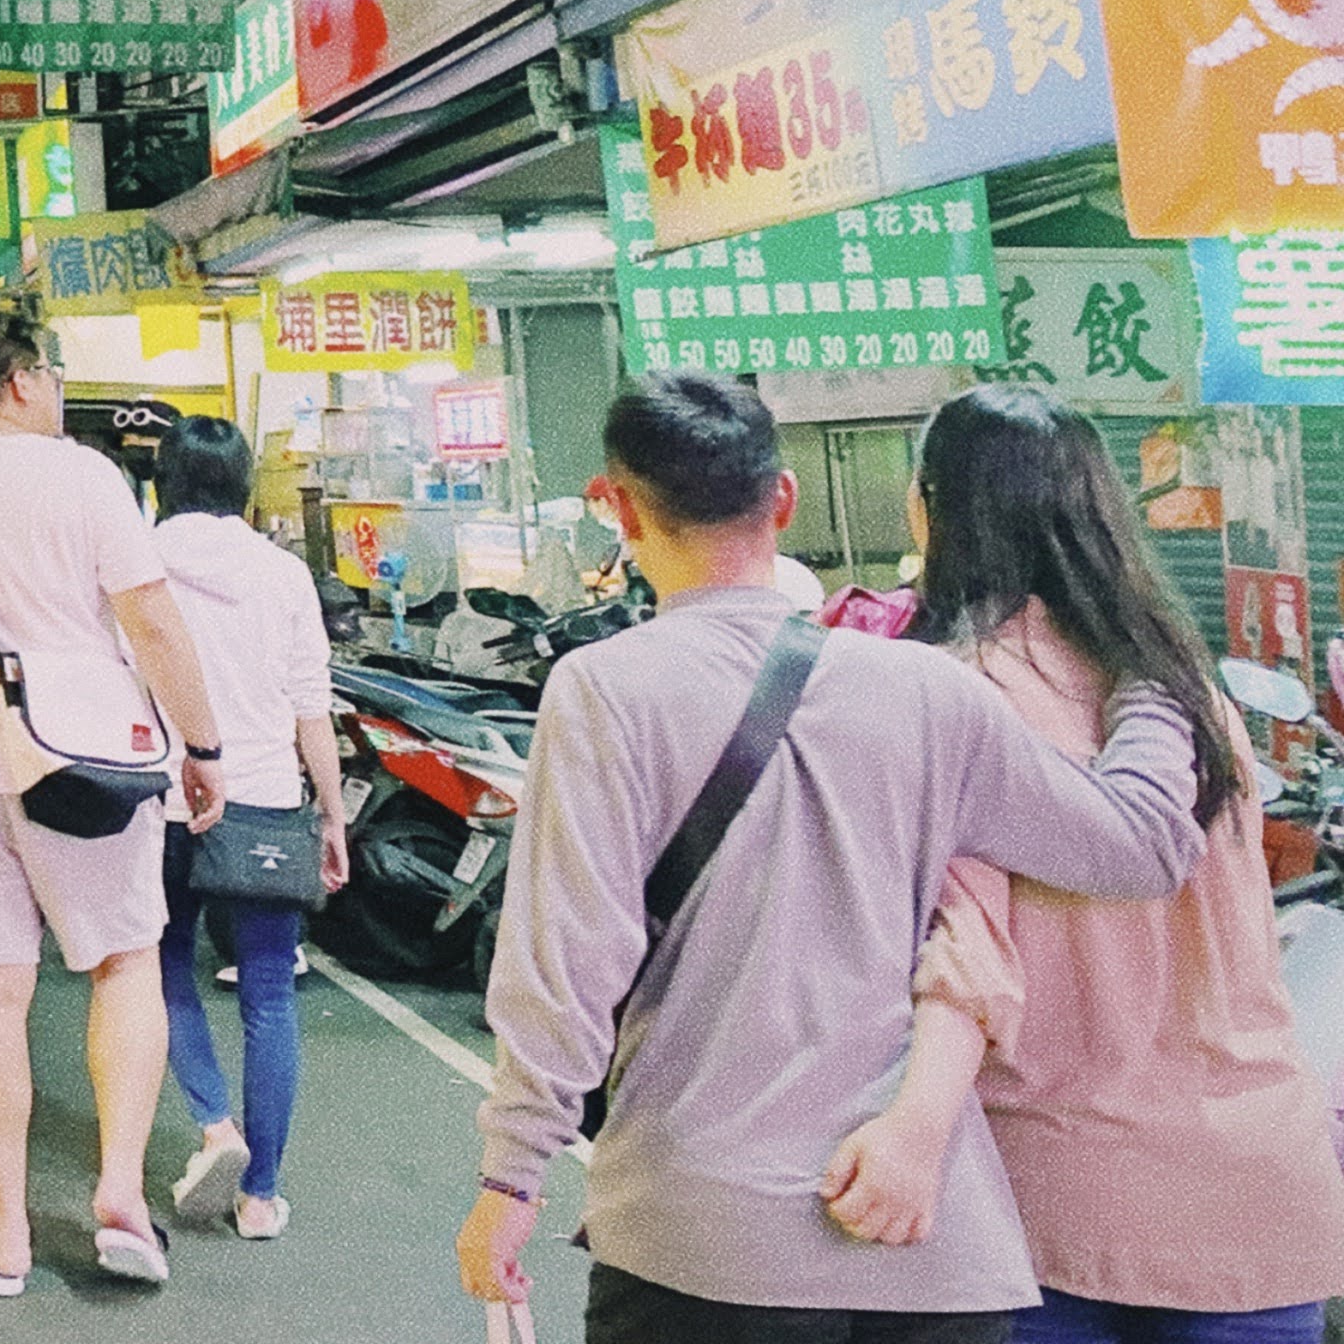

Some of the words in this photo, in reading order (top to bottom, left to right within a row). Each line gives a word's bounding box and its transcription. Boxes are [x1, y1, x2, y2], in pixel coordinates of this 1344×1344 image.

[20, 42, 45, 66] 40
[54, 42, 82, 66] 30
[90, 42, 116, 67] 20
[126, 42, 153, 67] 20
[161, 42, 189, 67] 20
[678, 339, 707, 370] 50
[714, 339, 741, 370] 50
[749, 337, 776, 368] 50
[784, 336, 812, 367] 40
[819, 335, 847, 367] 30
[854, 334, 883, 366] 20
[889, 333, 918, 364] 20
[925, 331, 955, 363] 20
[963, 329, 992, 361] 20
